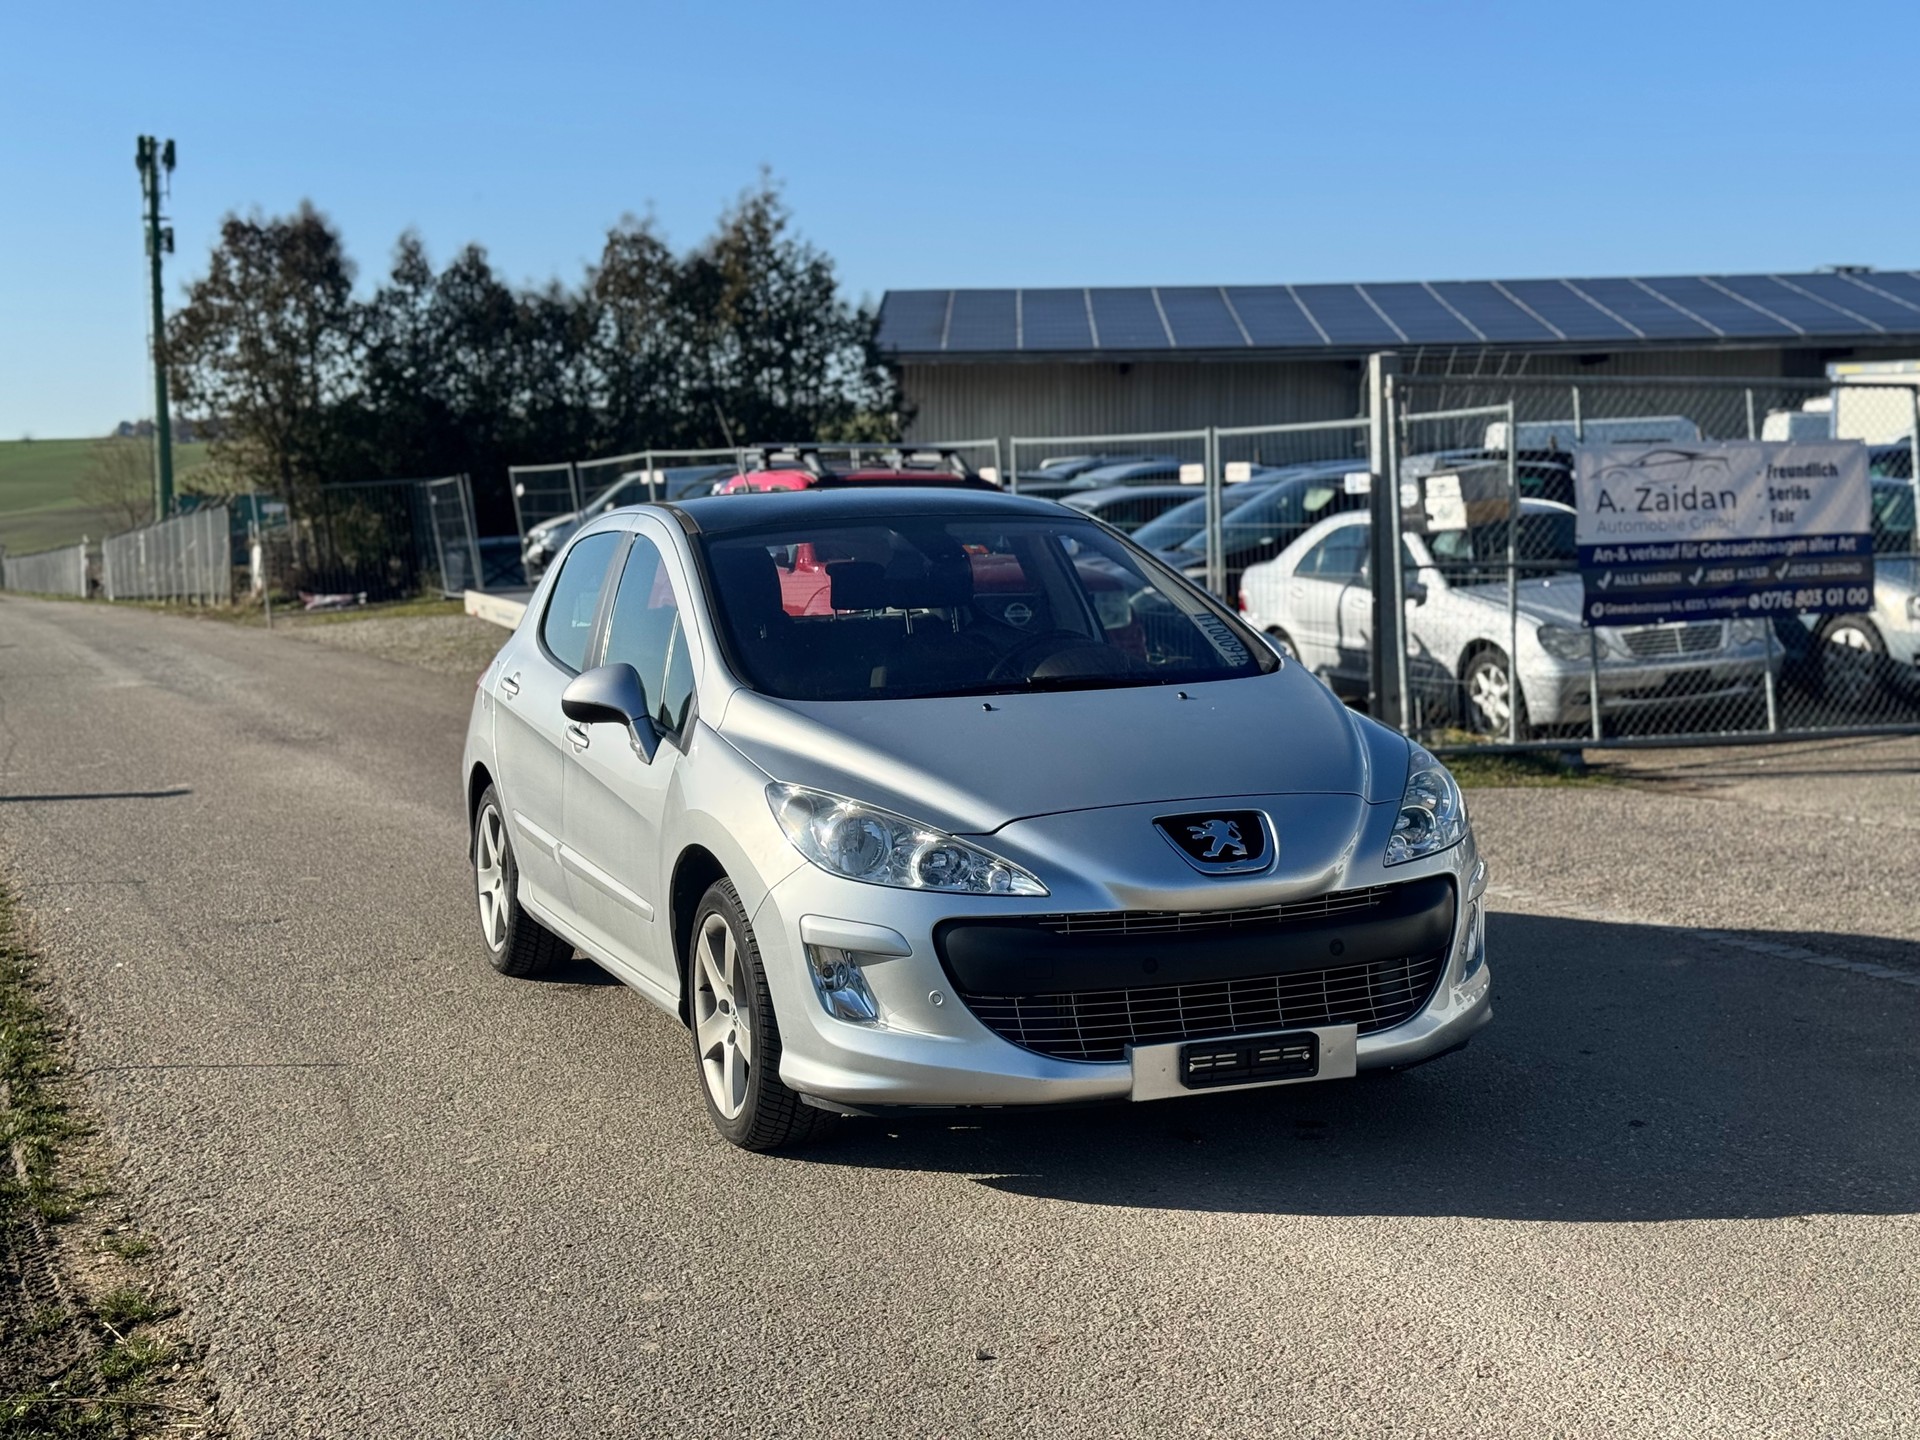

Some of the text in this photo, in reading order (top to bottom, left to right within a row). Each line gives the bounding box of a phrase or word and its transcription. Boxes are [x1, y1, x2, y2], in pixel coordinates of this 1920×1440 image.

[1766, 463, 1838, 479] Freundlich
[1595, 485, 1737, 513] A. Zaidan
[1768, 485, 1811, 501] Seriös
[1596, 516, 1736, 534] Automobile GmbH
[1771, 508, 1795, 524] Fair
[1629, 544, 1680, 561] verkauf
[1681, 543, 1698, 559] für
[1700, 539, 1808, 558] Gebrauchtwagen
[1809, 537, 1836, 552] aller
[1838, 536, 1857, 551] Art
[1614, 573, 1640, 586] ALLE
[1641, 571, 1682, 584] MARKEN
[1705, 568, 1735, 582] JEDES
[1736, 566, 1769, 580] ALTER
[1760, 590, 1793, 610] 076
[1795, 588, 1823, 607] 803
[1825, 588, 1844, 606] 01
[1847, 587, 1869, 605] 00
